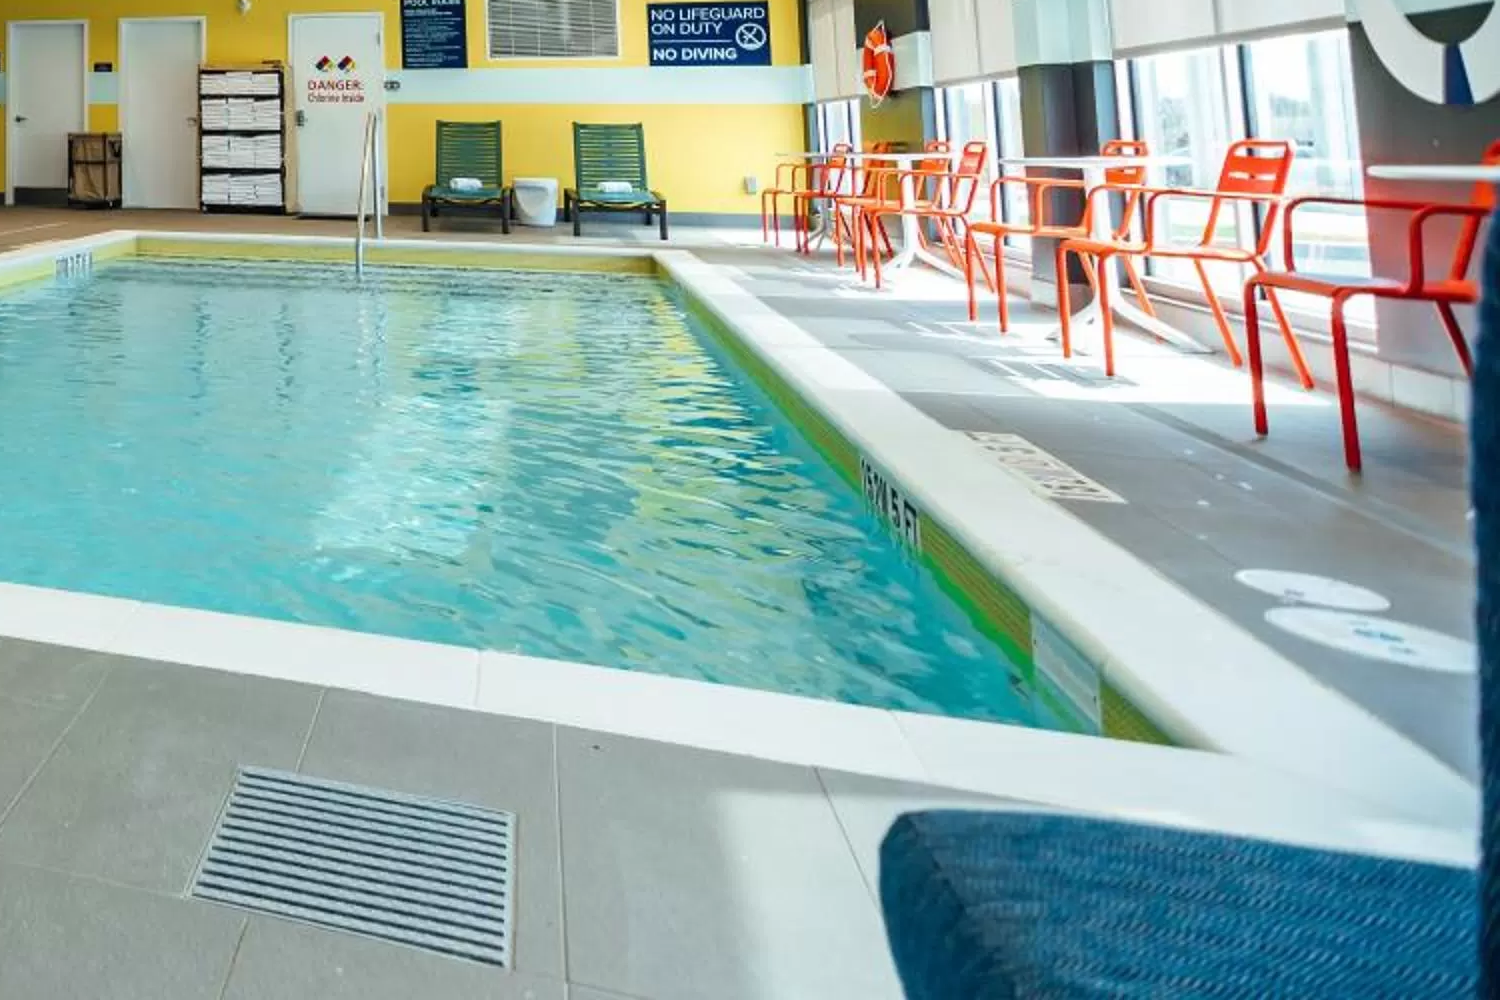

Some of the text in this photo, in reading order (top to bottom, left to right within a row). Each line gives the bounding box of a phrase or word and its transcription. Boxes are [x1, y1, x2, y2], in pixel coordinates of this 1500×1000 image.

[651, 7, 765, 21] NO LIFEGUARD
[651, 22, 723, 35] ON DUTY
[653, 47, 738, 61] NO DIVING
